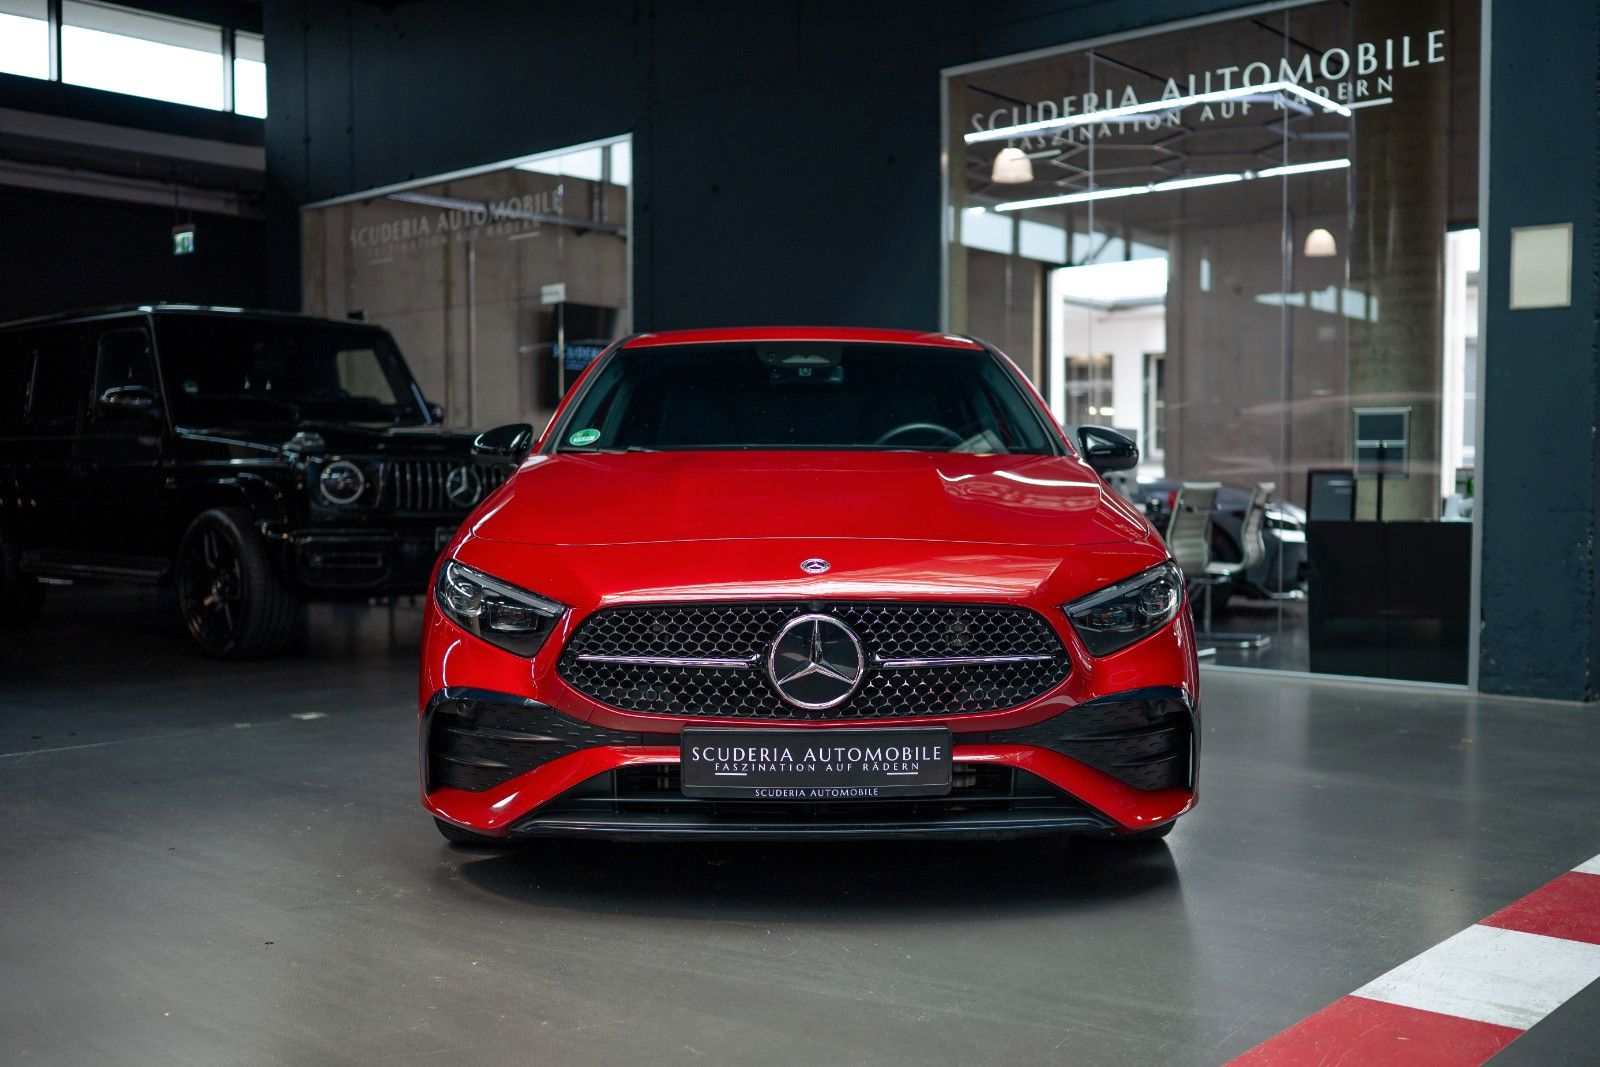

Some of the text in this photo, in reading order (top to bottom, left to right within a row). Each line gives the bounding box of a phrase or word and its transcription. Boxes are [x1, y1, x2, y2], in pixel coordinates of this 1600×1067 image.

[1161, 29, 1447, 105] AUTOMOBILE
[692, 746, 941, 763] SCUDERIA AUTOMOBILE
[715, 762, 919, 772] FASZINATION AUF RÄDERN
[755, 788, 879, 797] SCUDERIA AUTOMOBILE
